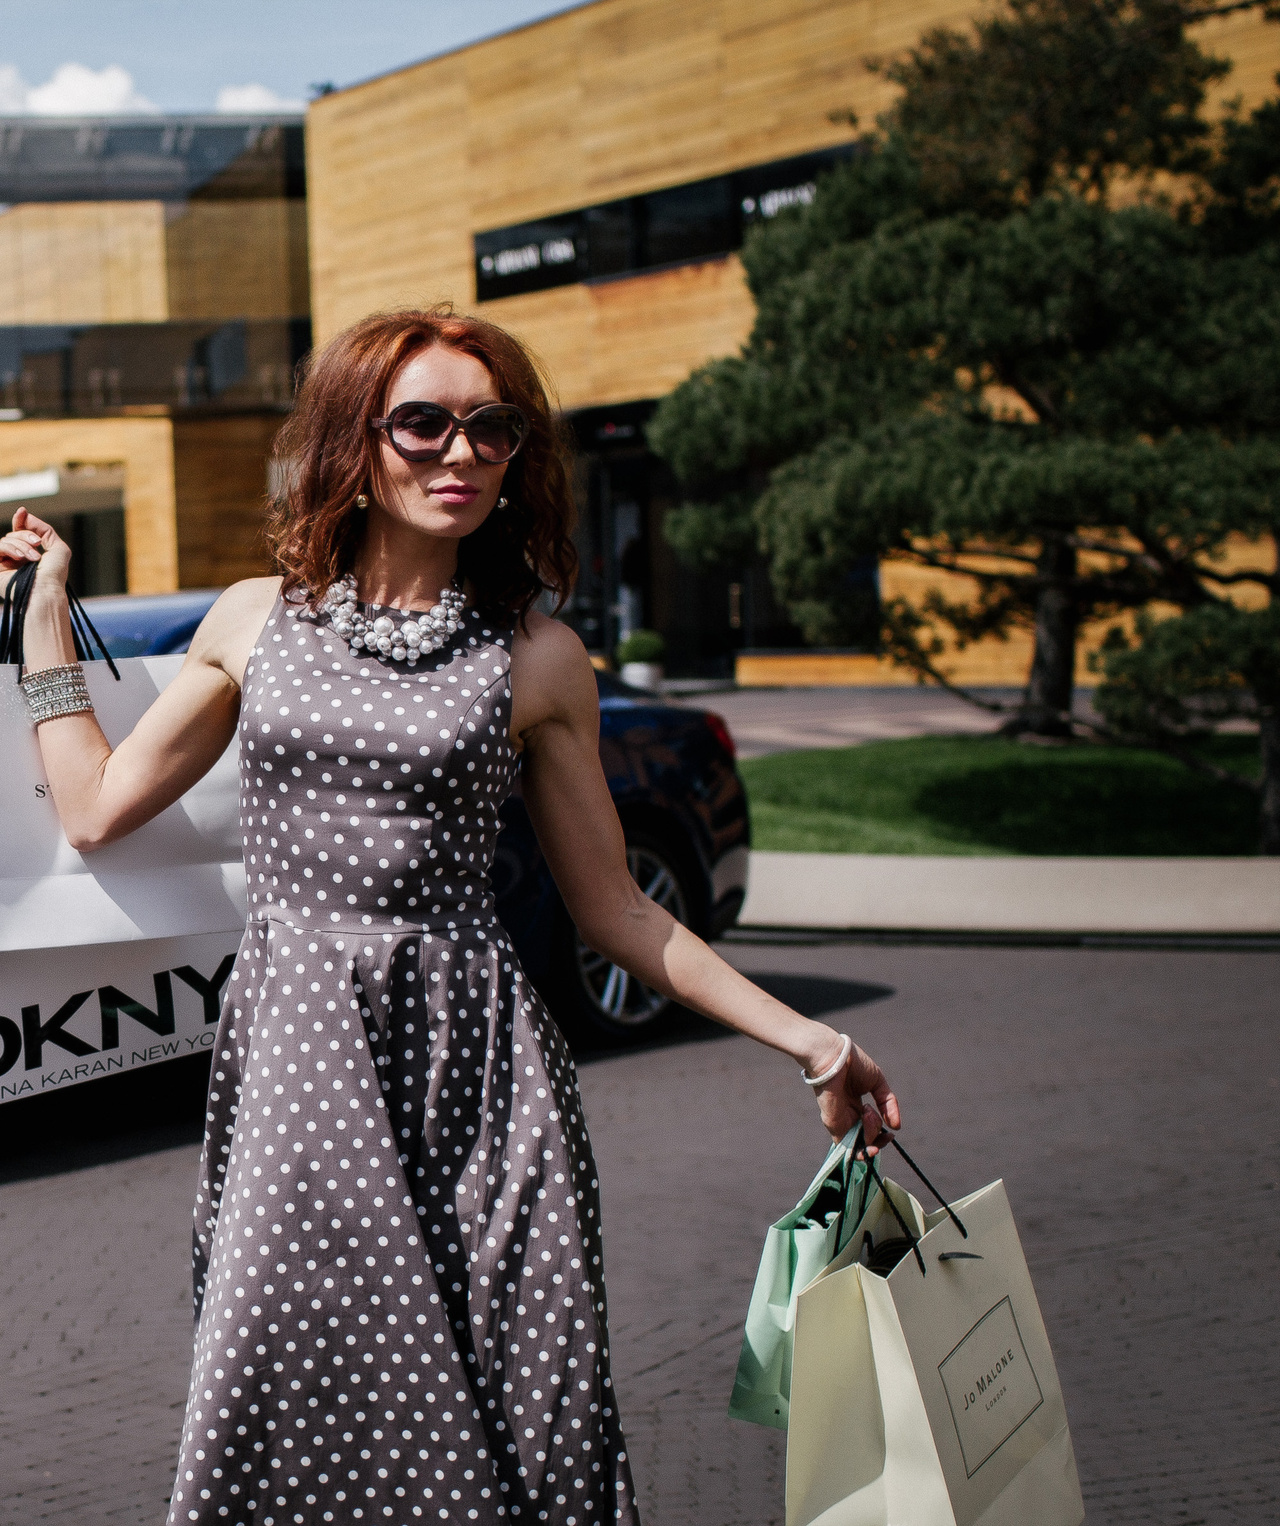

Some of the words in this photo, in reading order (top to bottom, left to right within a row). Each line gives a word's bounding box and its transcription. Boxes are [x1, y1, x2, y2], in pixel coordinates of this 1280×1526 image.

[41, 1055, 123, 1088] KARAN
[132, 1040, 180, 1063] NEW
[185, 1032, 216, 1049] YO
[976, 1349, 1014, 1395] MALONE
[985, 1386, 1007, 1411] LONDON
